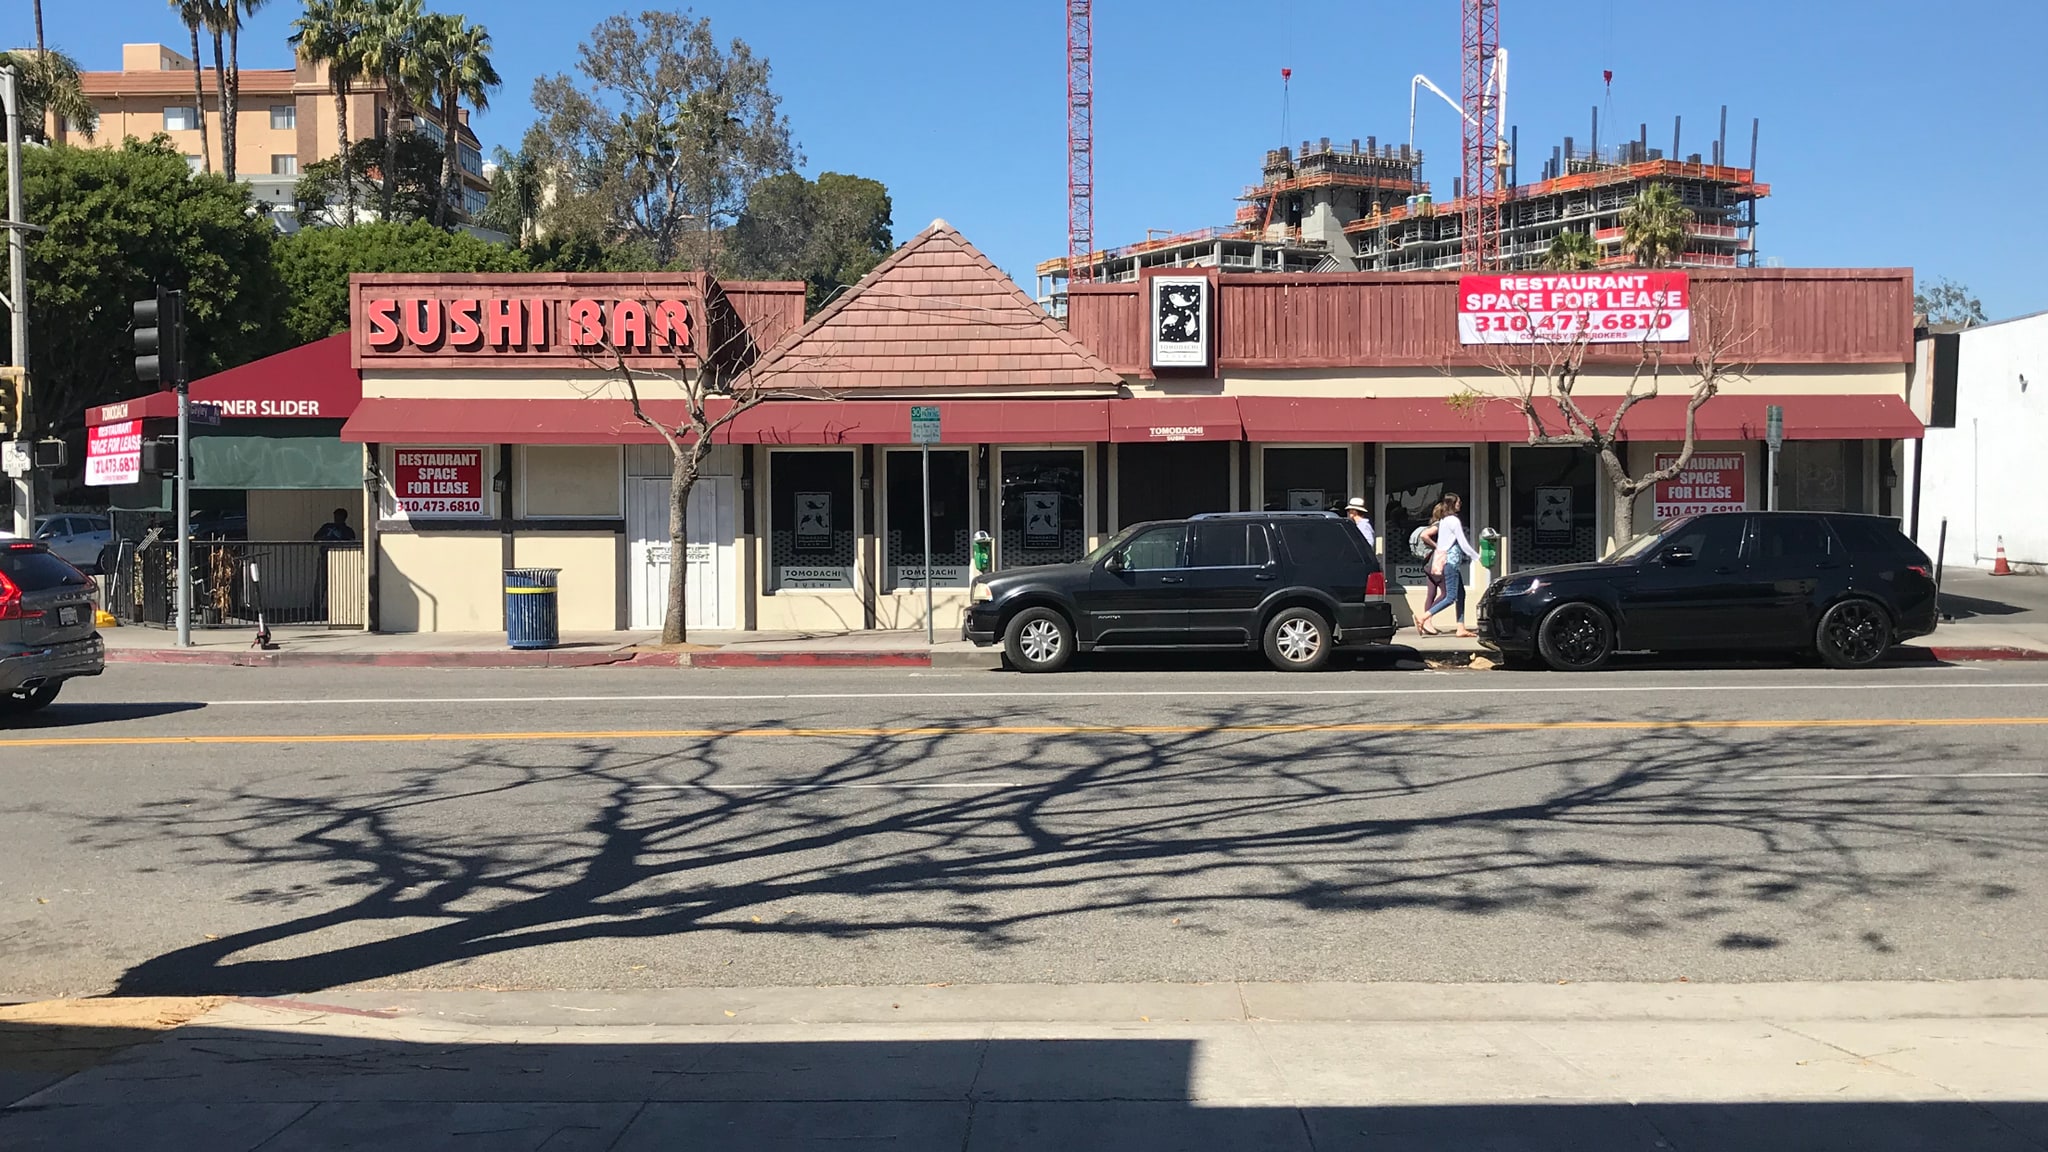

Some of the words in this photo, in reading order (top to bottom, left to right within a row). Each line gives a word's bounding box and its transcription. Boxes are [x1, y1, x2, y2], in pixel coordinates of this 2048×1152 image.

[1500, 275, 1648, 291] RESTAURANT
[1466, 292, 1543, 311] SPACE
[1551, 291, 1599, 309] FOR
[1607, 290, 1682, 309] LEASE
[368, 299, 545, 346] SUSHI
[568, 299, 690, 347] BAR
[260, 400, 319, 415] SLIDER
[911, 407, 921, 417] 30
[1149, 426, 1204, 434] TOMODACHI
[398, 453, 477, 466] RESTAURANT
[1659, 457, 1740, 470] REAURANT
[418, 467, 458, 480] SPACE
[1680, 471, 1720, 485] SPACE
[407, 481, 431, 494] FOR
[433, 481, 469, 494] LEASE
[1668, 486, 1692, 499] FOR
[1695, 486, 1732, 499] LEASE
[397, 500, 480, 512] 310.473.6810
[1657, 505, 1743, 517] 3104736810
